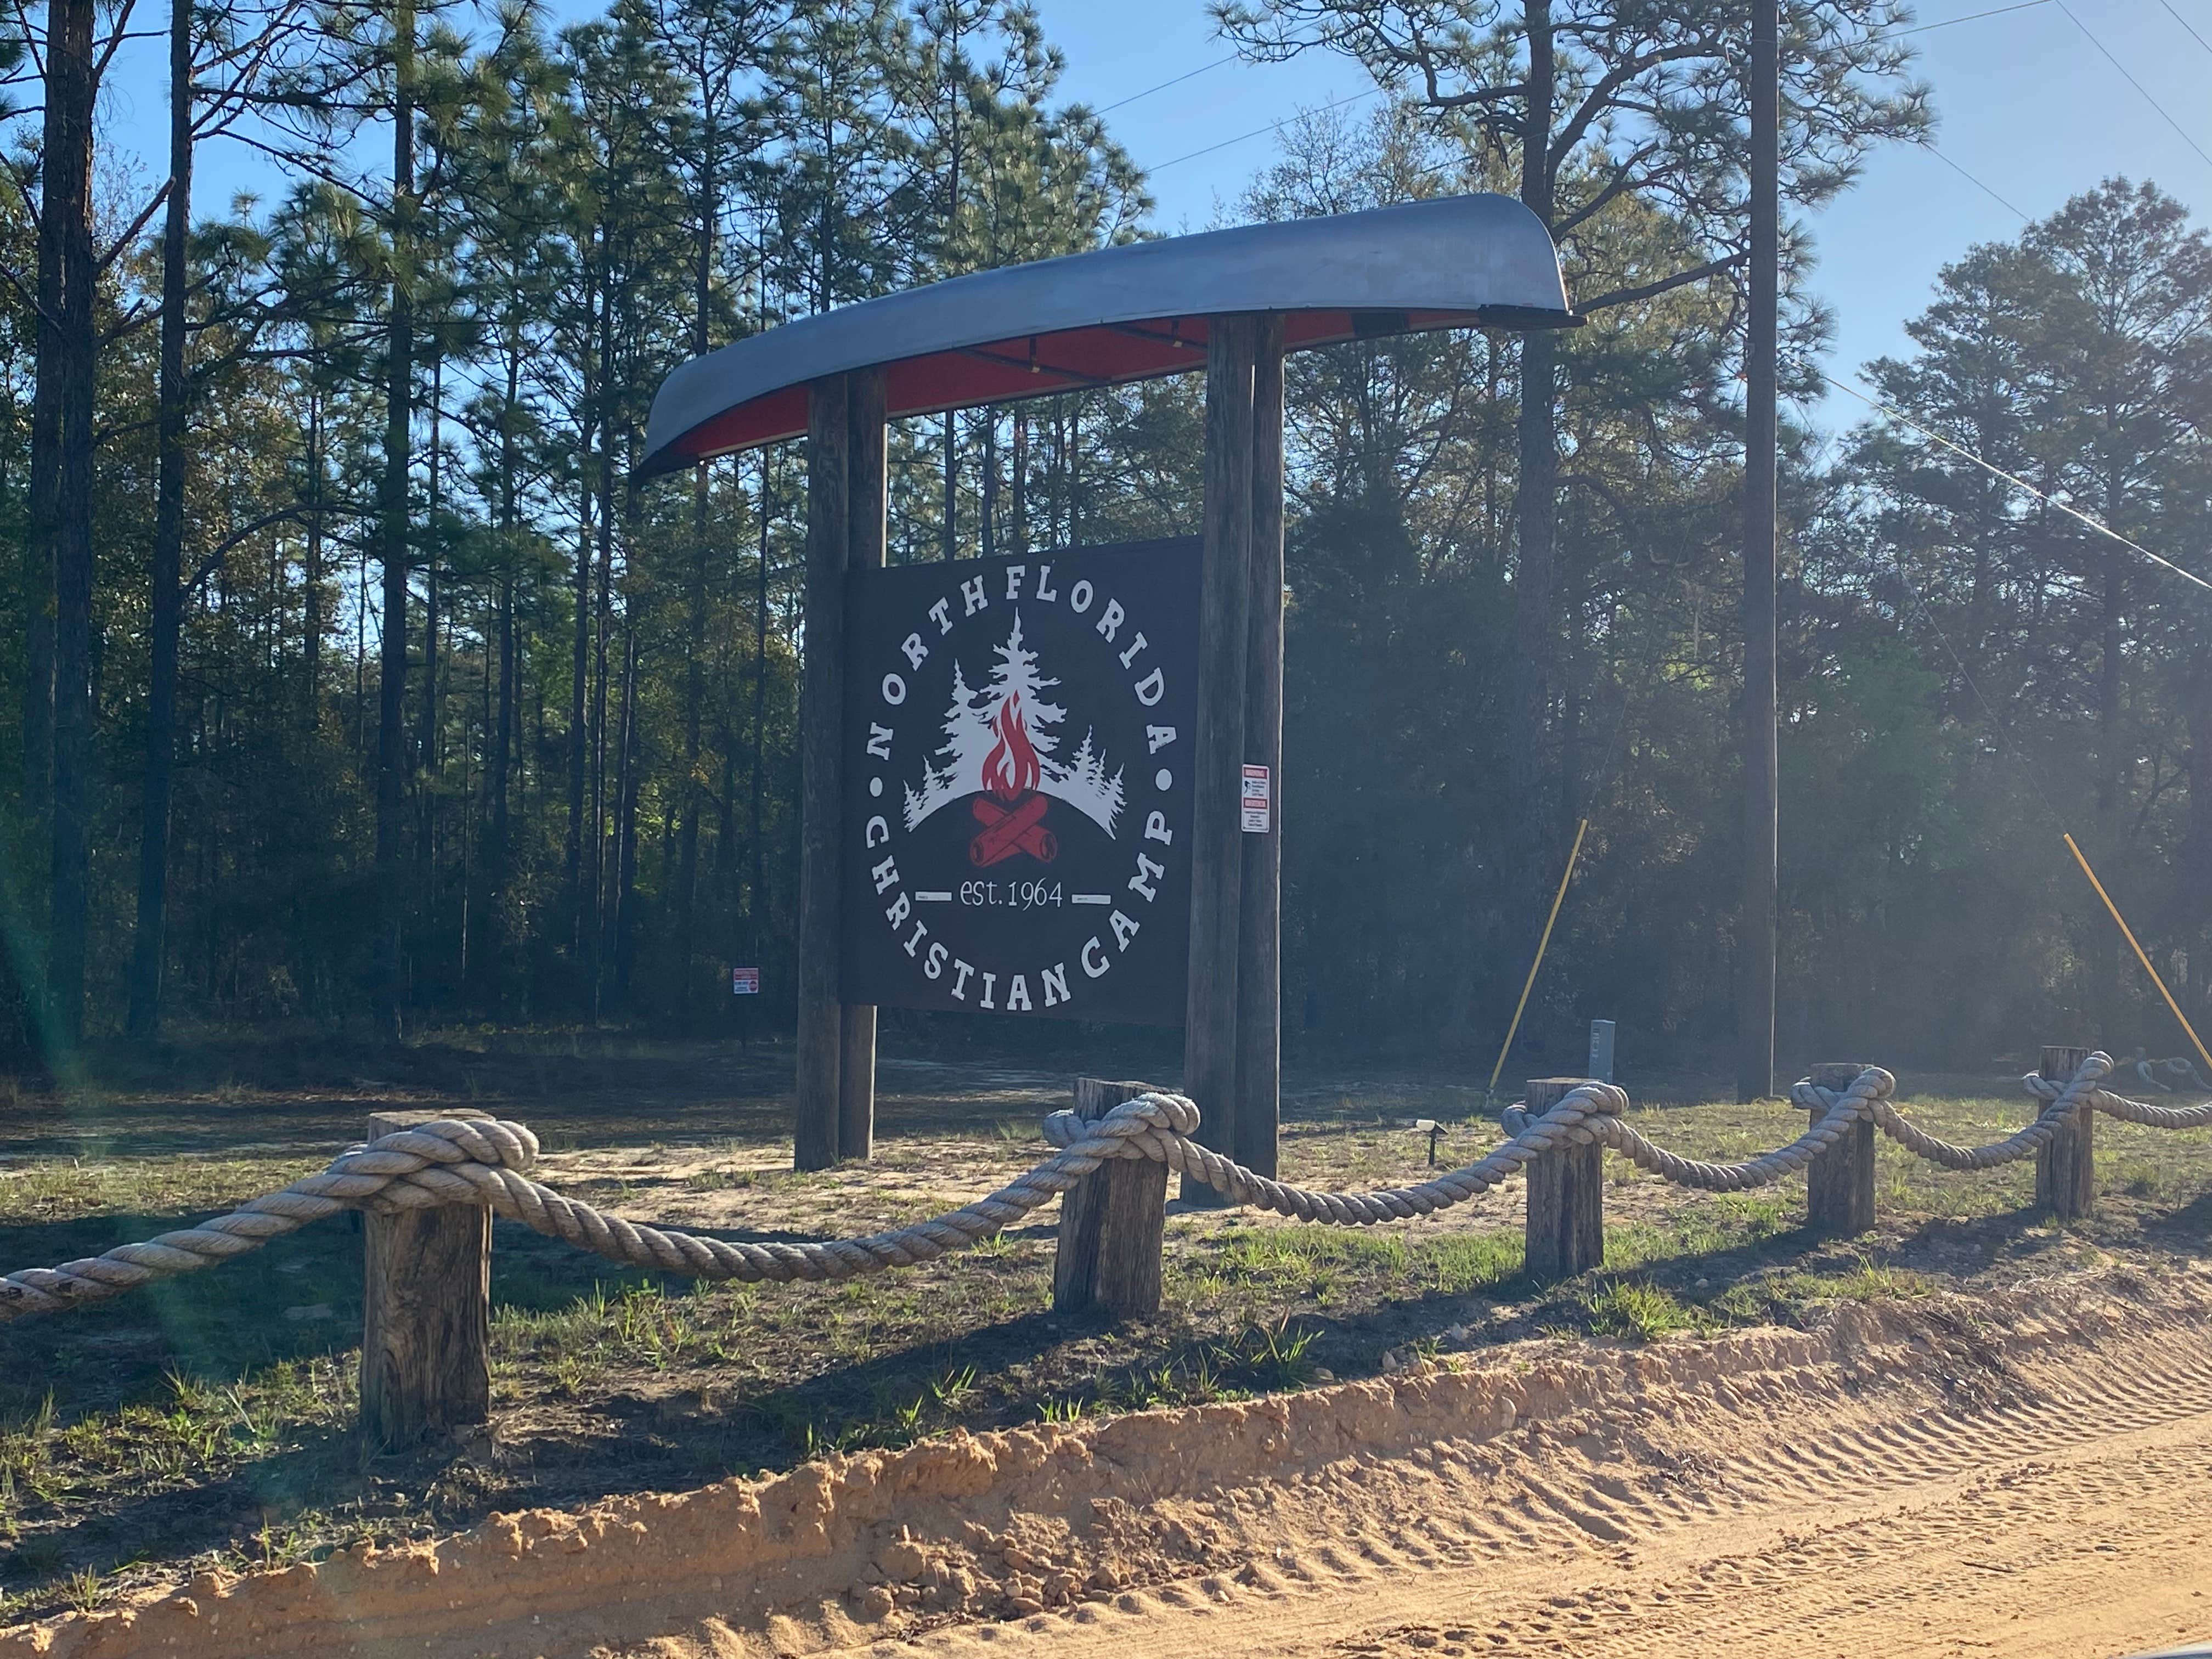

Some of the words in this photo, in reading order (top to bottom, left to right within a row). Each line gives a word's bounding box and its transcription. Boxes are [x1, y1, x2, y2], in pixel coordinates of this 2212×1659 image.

[866, 574, 989, 761] NORTH
[1005, 565, 1177, 756] FLORIDA
[865, 815, 1071, 1011] CHRISTIAN
[1080, 810, 1174, 979] CAMP
